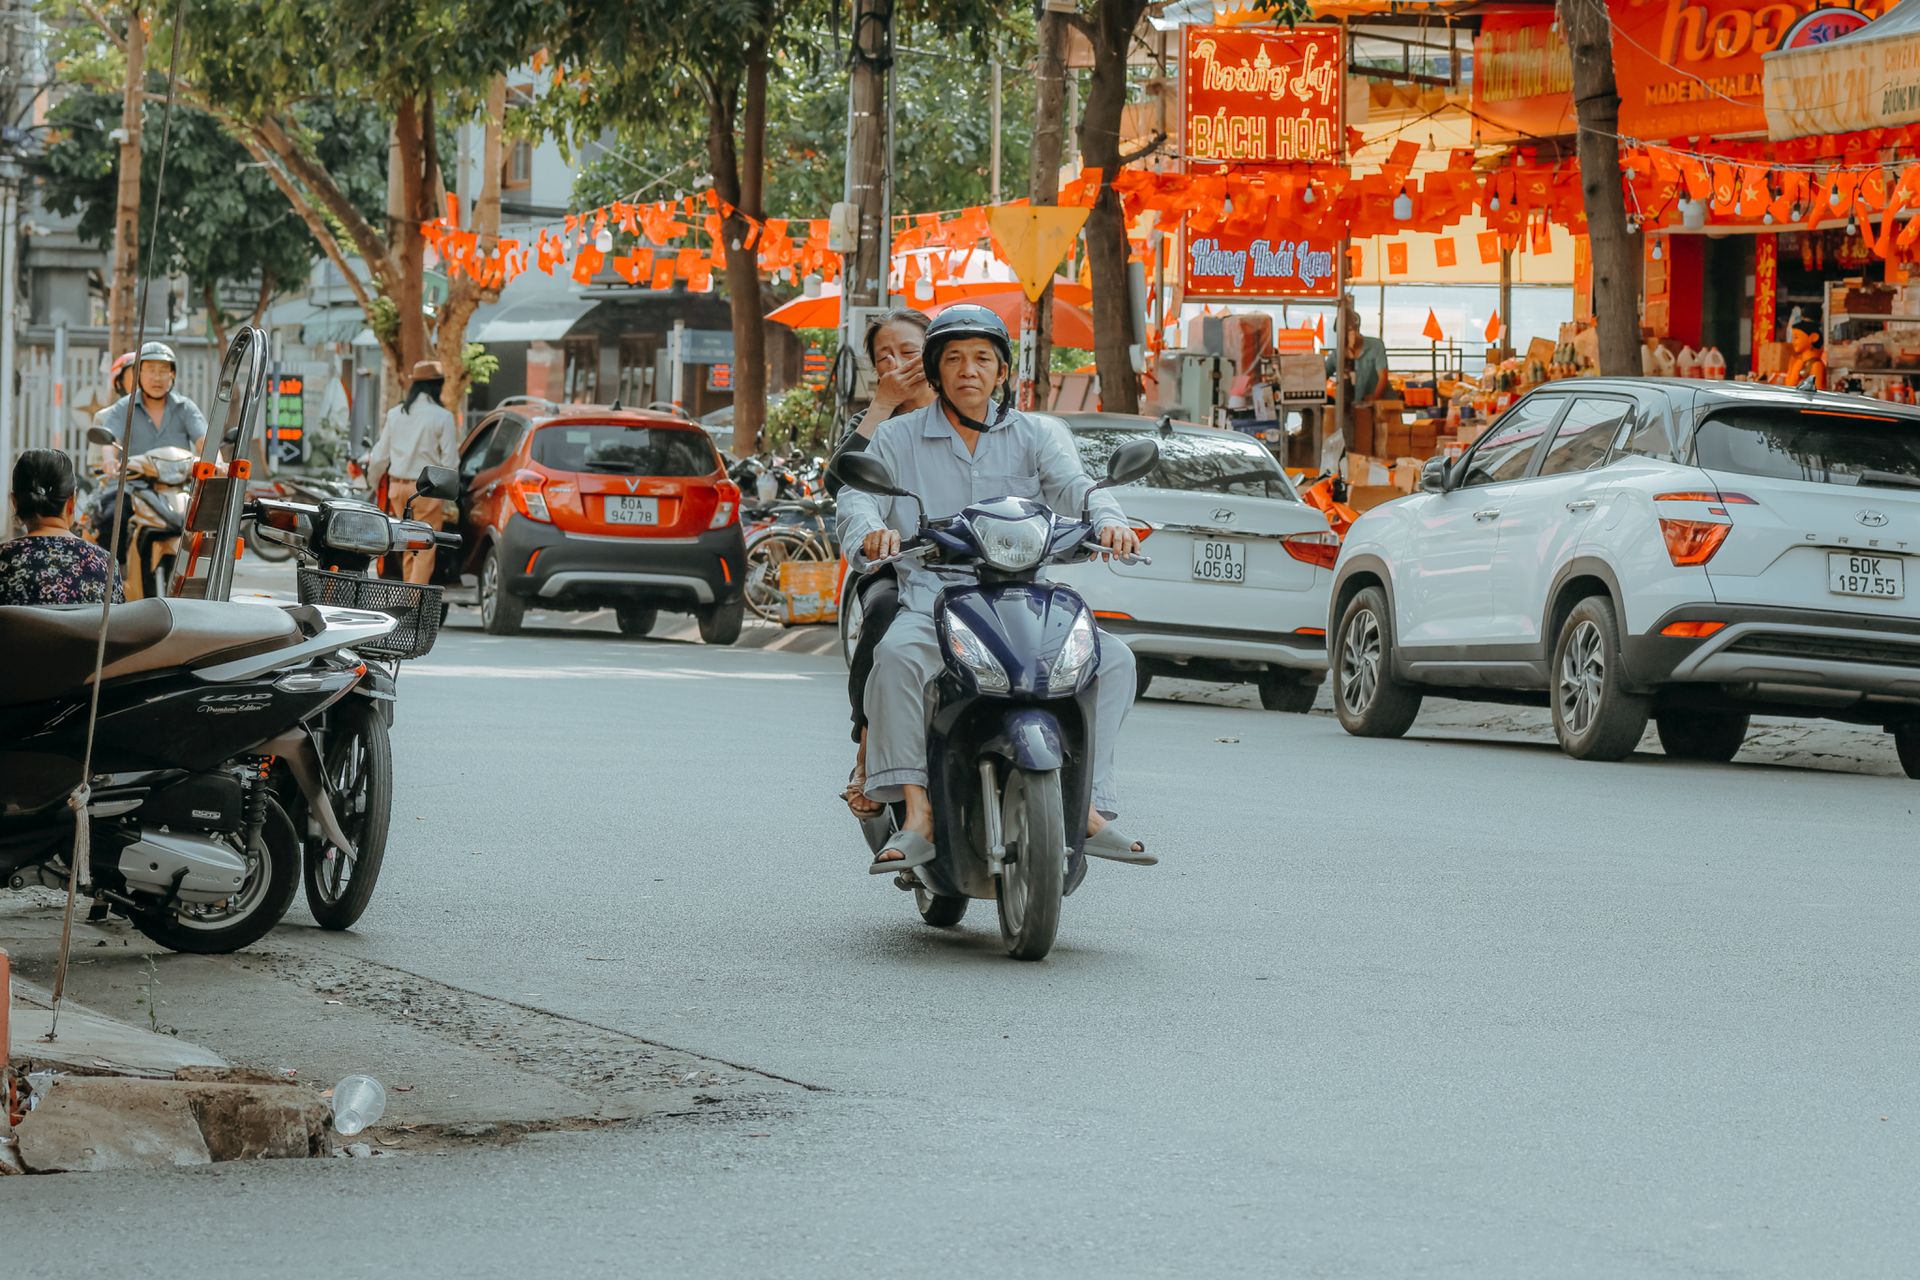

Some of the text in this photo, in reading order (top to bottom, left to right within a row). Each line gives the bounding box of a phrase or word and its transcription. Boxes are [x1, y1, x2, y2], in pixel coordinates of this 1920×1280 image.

[1645, 82, 1689, 105] MADE
[1707, 74, 1763, 99] THAILA
[1192, 107, 1332, 160] BÁCH HÓA
[1191, 238, 1332, 288] Hàng Thái Lan
[620, 498, 643, 510] 60A
[611, 510, 652, 523] 947.78
[1205, 543, 1232, 561] 60A
[1194, 560, 1243, 580] 405.93
[1850, 557, 1881, 576] 60K
[1839, 575, 1896, 595] 187.55
